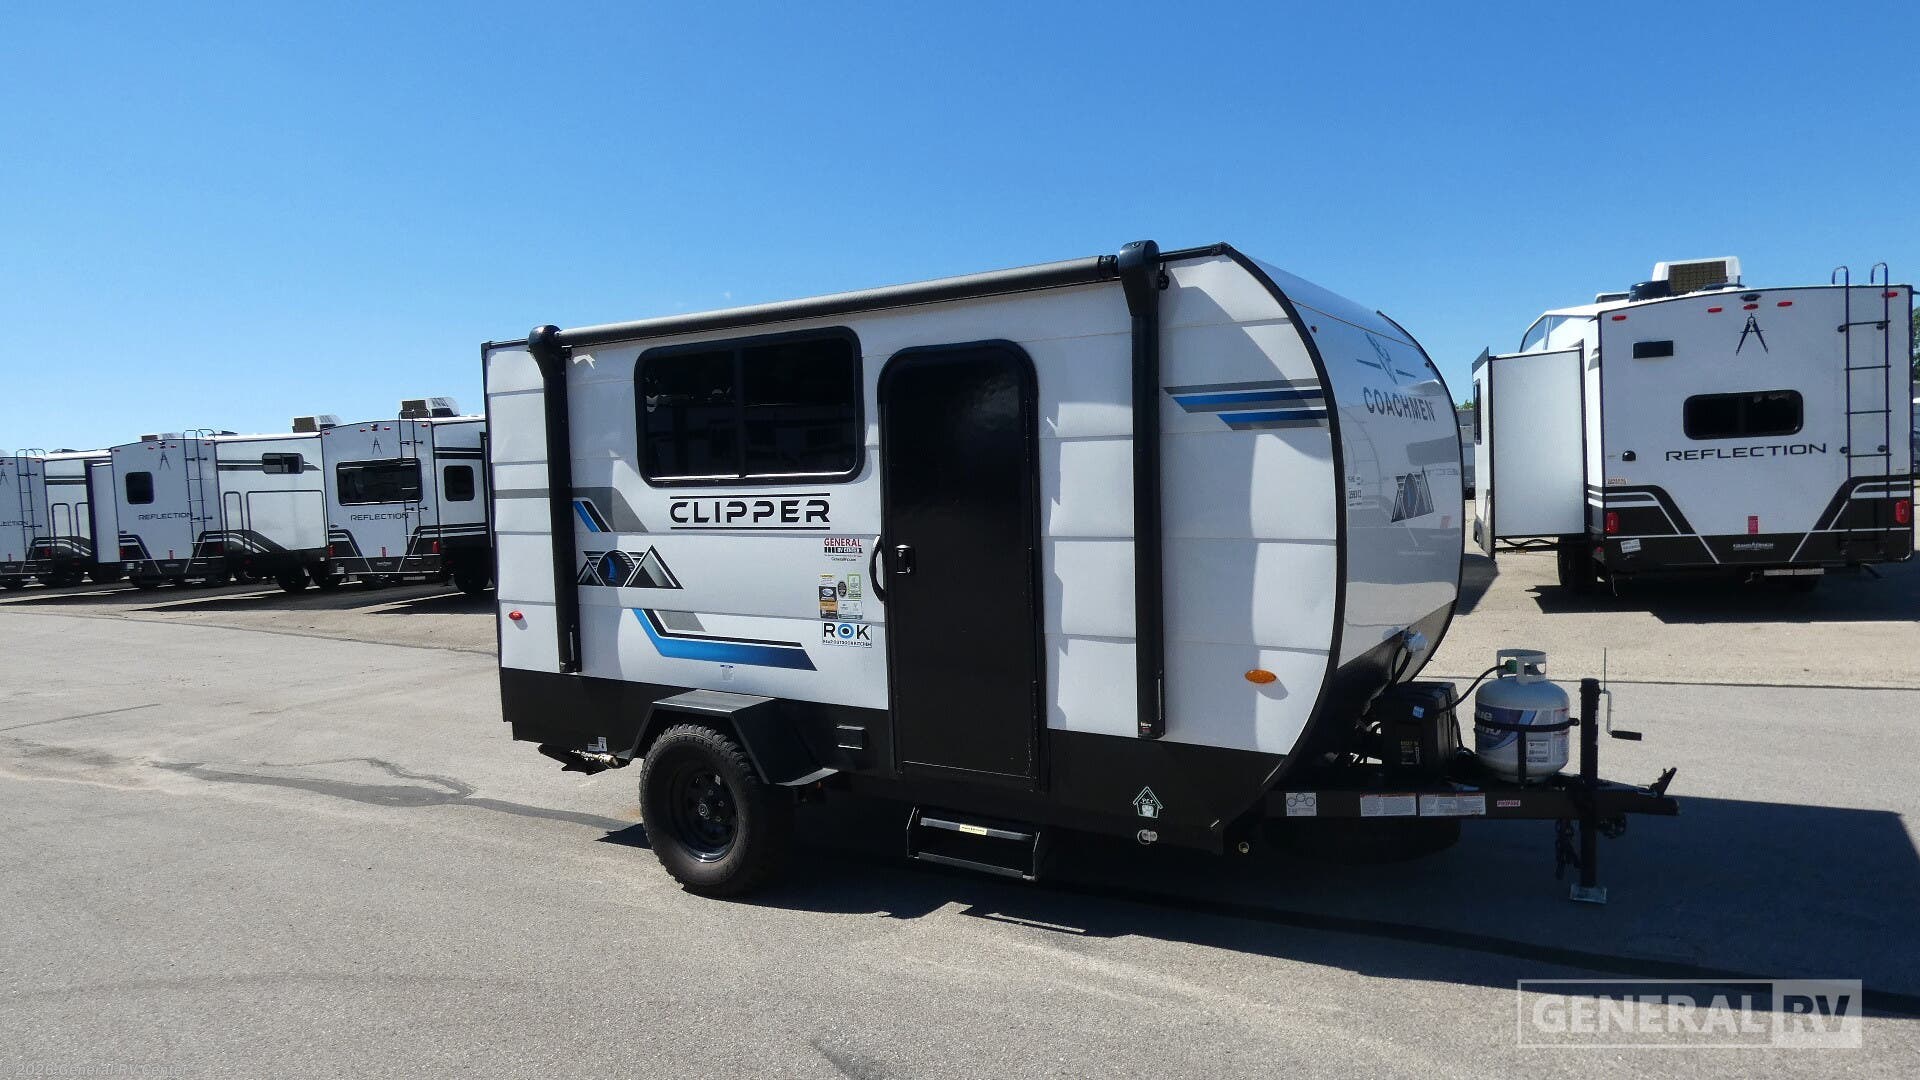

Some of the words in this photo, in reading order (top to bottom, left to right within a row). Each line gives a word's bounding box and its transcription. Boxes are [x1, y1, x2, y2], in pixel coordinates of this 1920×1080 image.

[1363, 387, 1436, 422] COACHMEN
[1665, 443, 1827, 461] REFLECTION
[138, 512, 193, 521] REFLECTION
[350, 512, 409, 521] REFLECTION
[669, 499, 831, 524] CLIPPER
[823, 537, 862, 547] GENERAL
[823, 622, 871, 640] ROK
